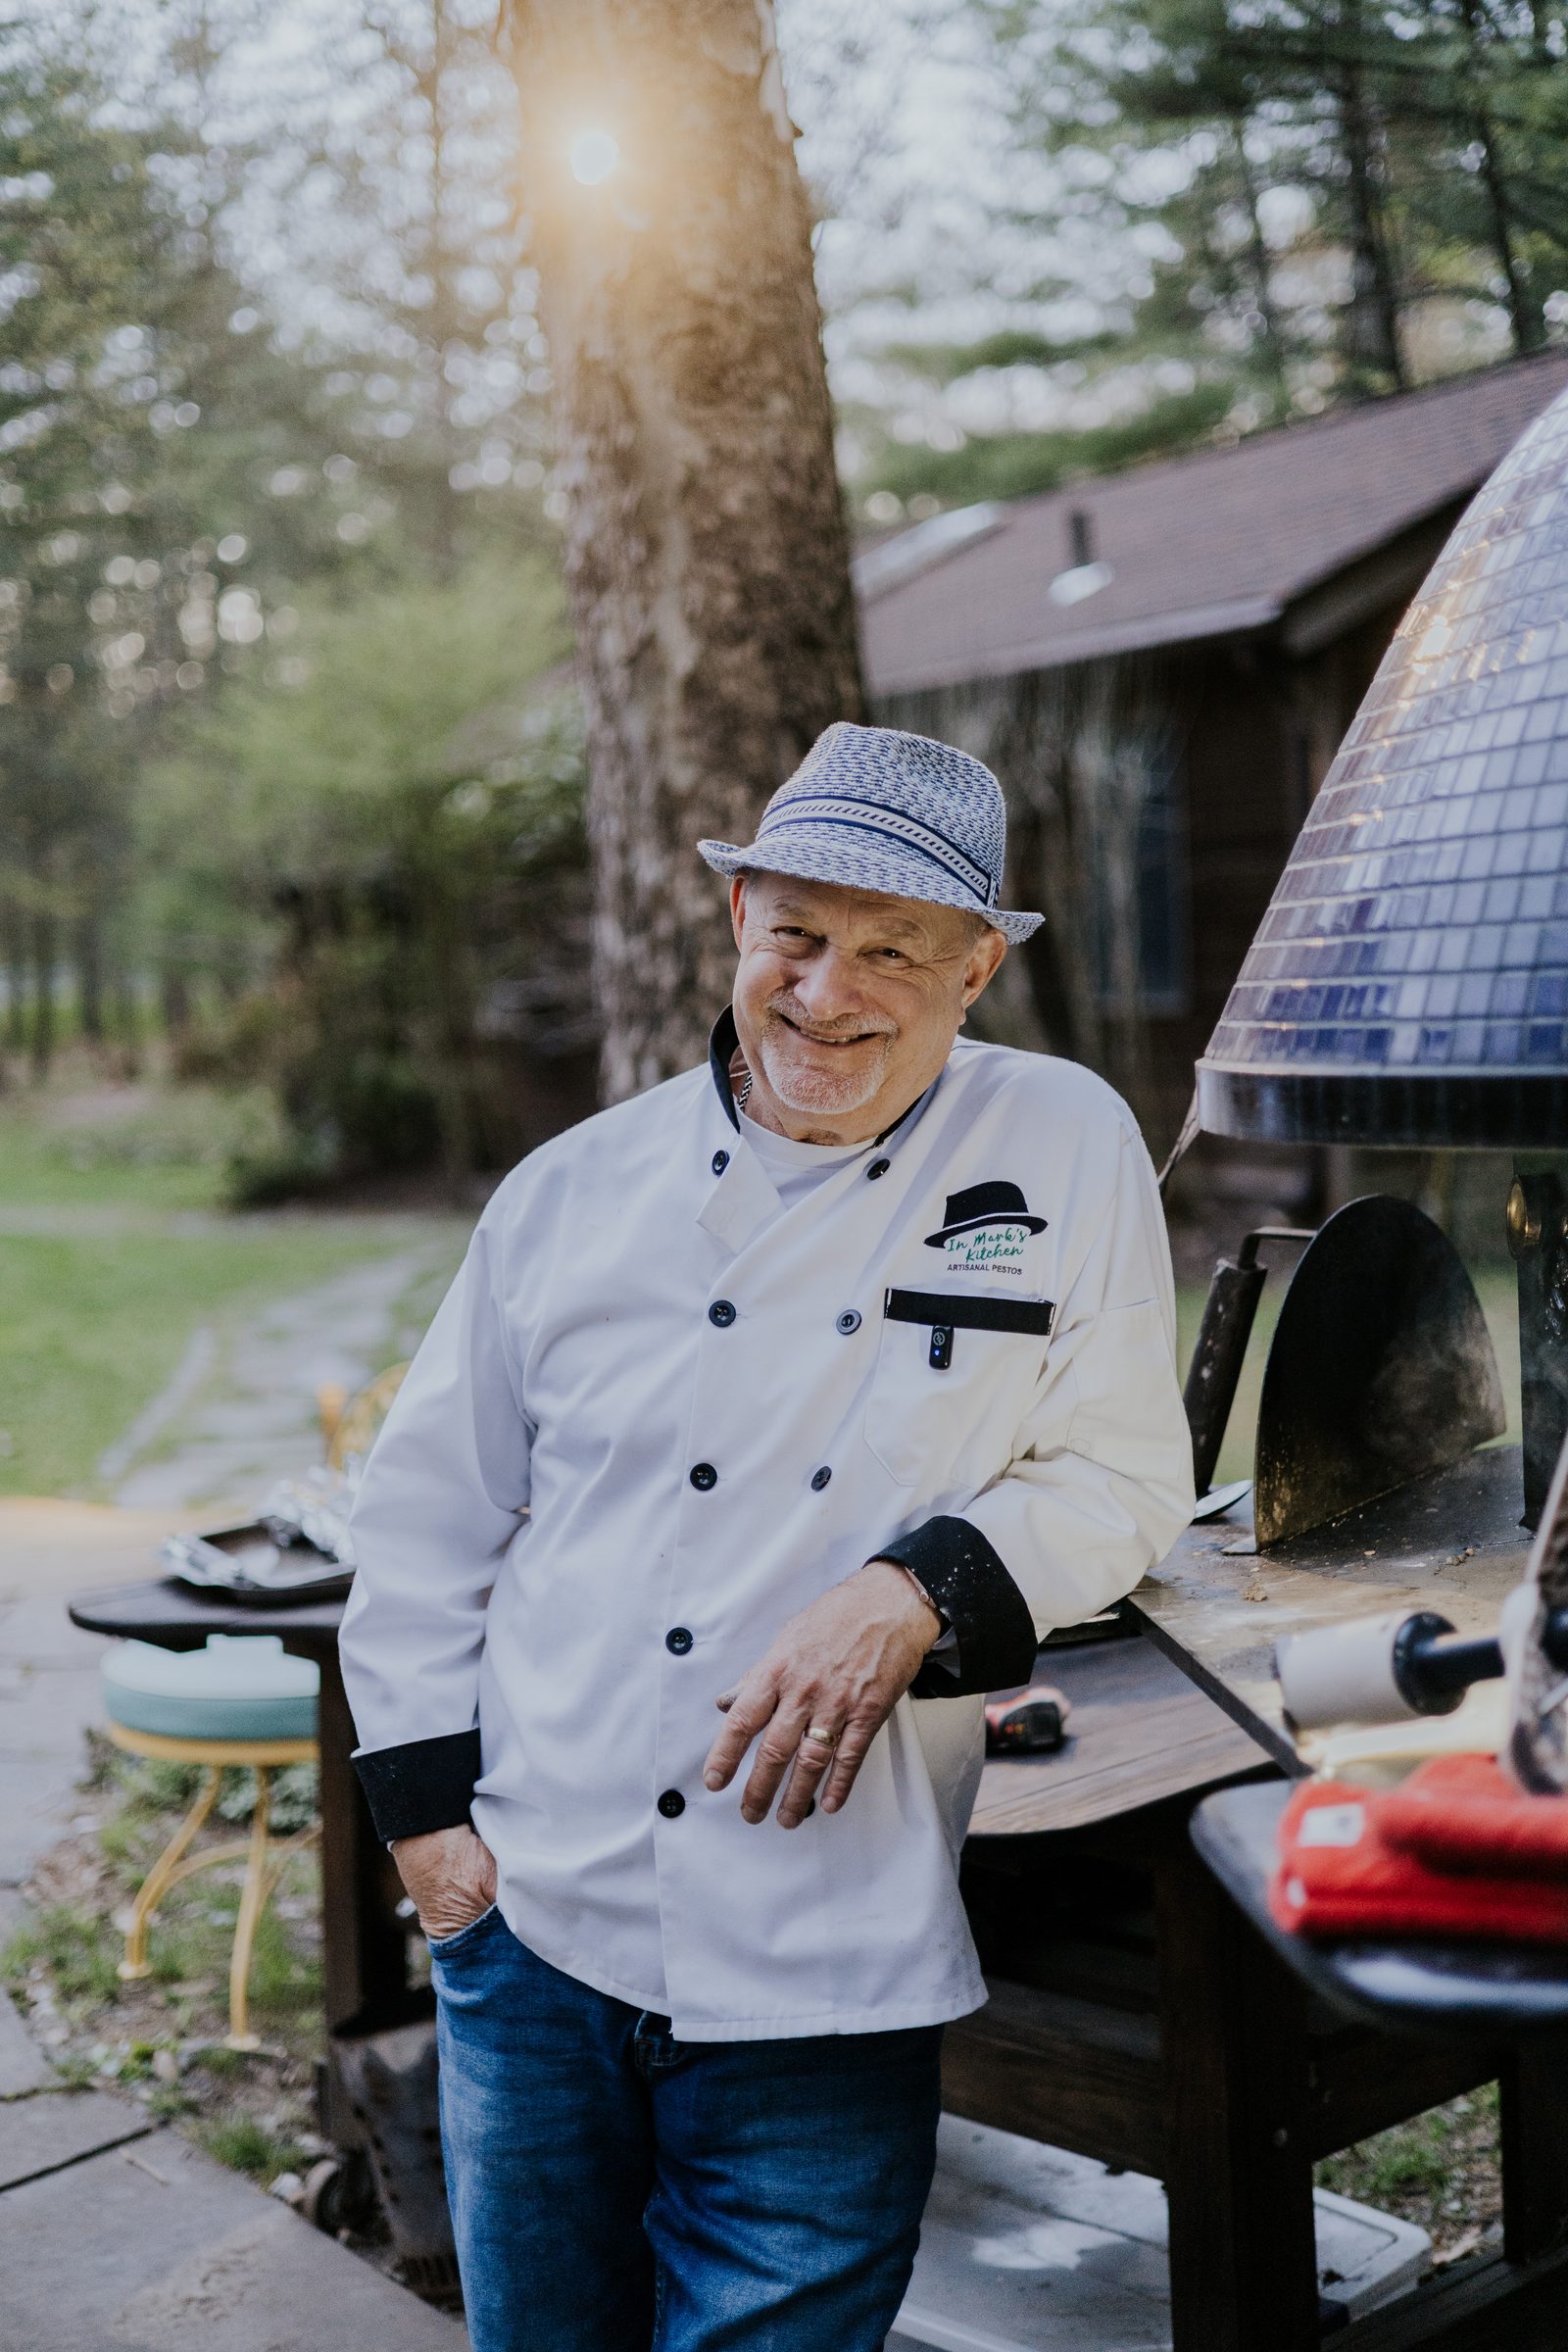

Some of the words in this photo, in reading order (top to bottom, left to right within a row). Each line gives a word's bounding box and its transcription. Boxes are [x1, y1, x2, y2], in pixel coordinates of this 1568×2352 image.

[948, 1239, 968, 1252] In
[973, 1227, 1027, 1248] Mark's
[965, 1244, 1024, 1263] Kitchen
[992, 1264, 1023, 1275] PESTOS
